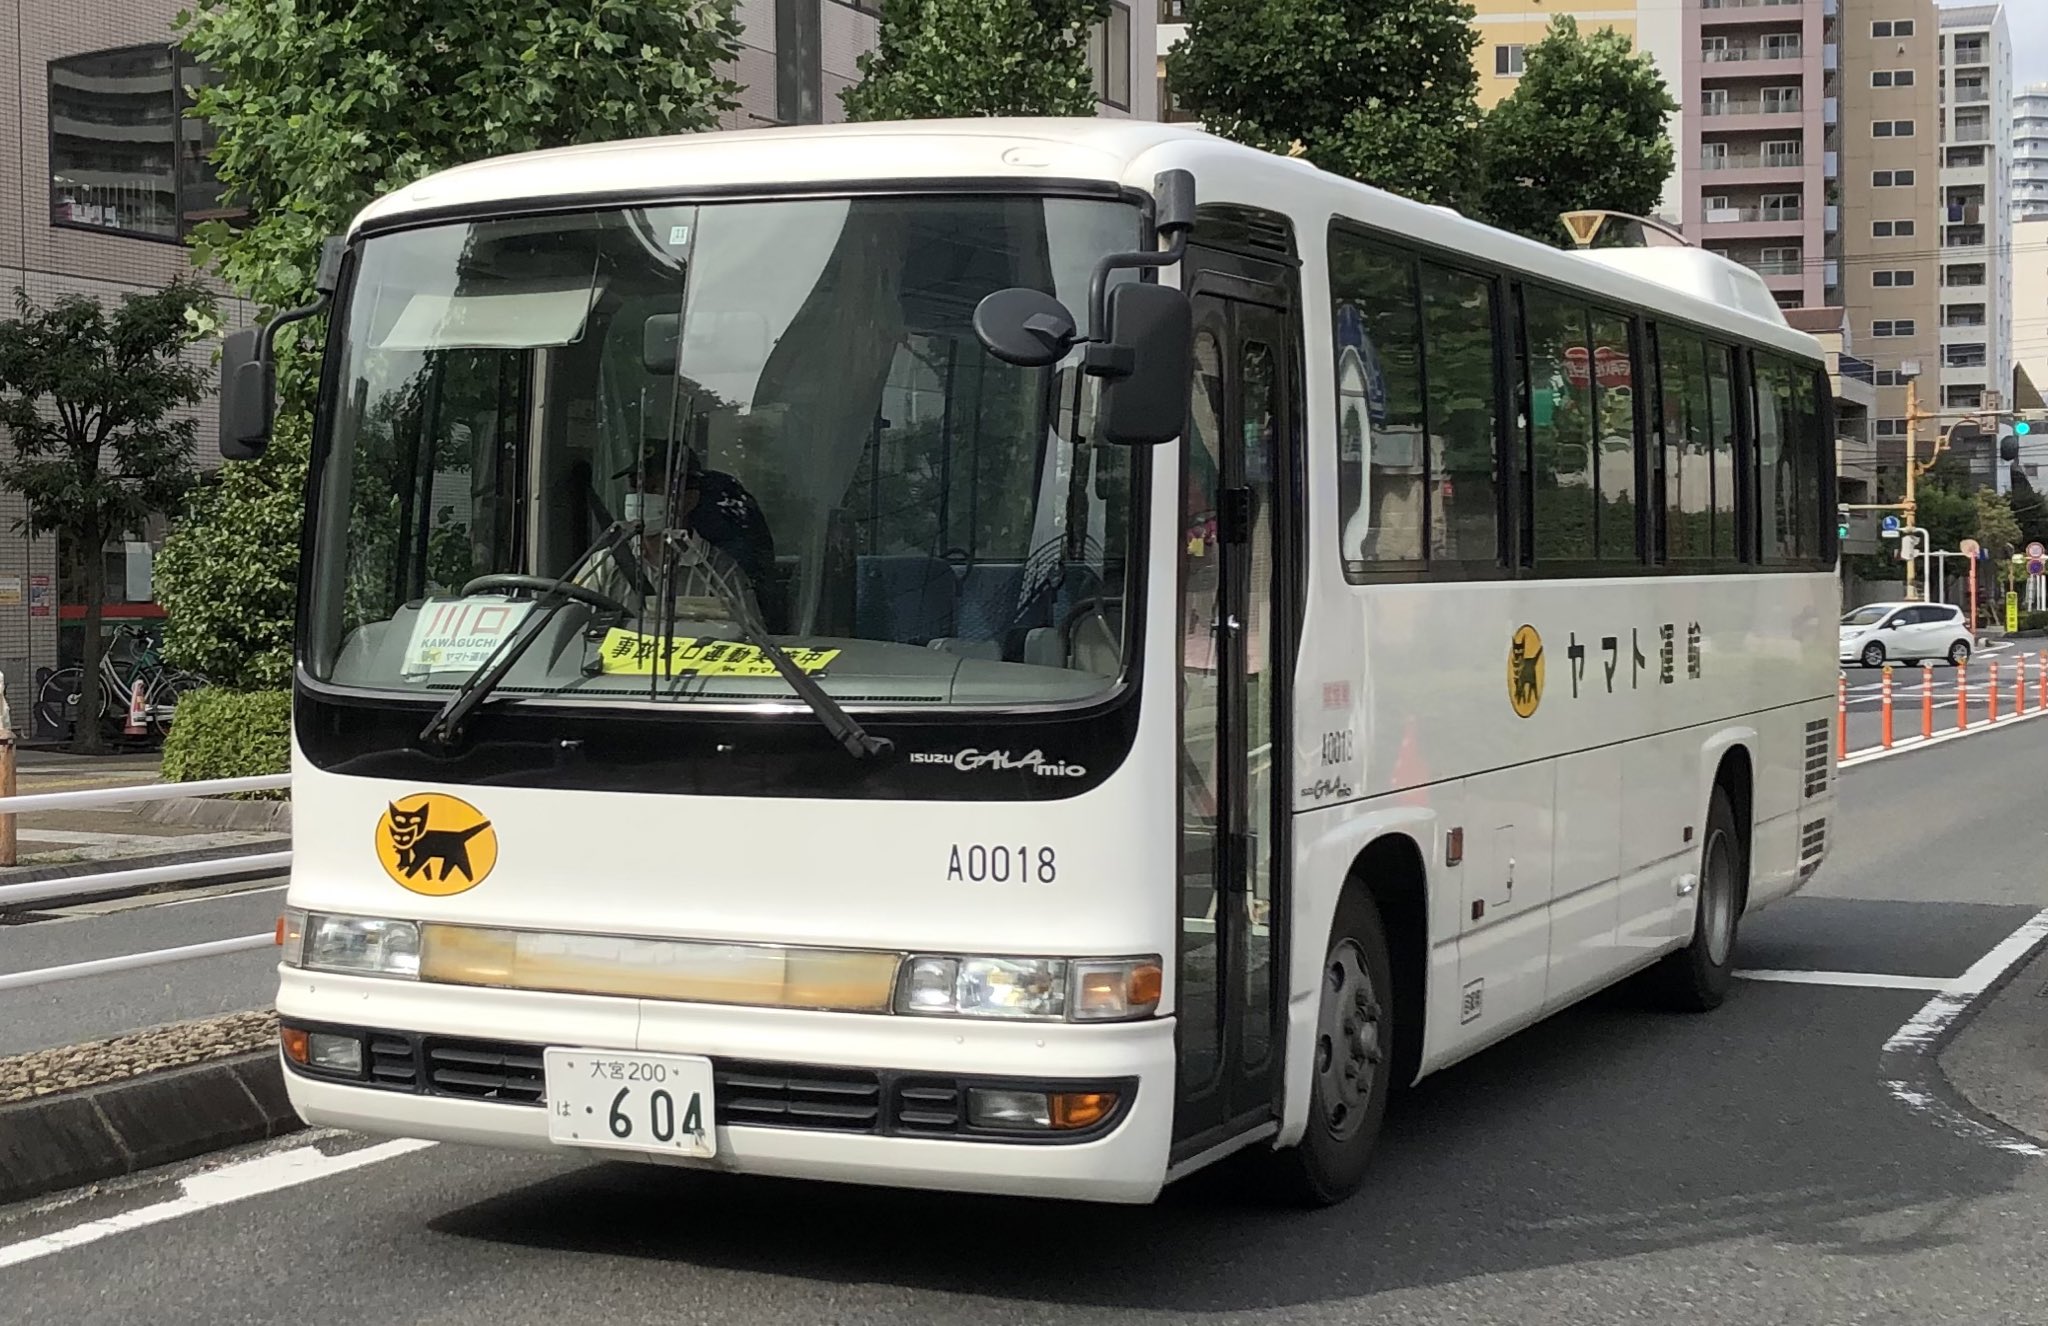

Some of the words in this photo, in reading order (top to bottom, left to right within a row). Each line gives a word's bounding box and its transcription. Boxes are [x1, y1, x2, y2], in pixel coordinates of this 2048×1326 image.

[424, 604, 512, 640] 川口
[421, 638, 498, 648] KAWAGUCHI
[1566, 621, 1701, 699] ヤマト運輸
[910, 753, 954, 763] ISUZU
[947, 844, 1056, 884] A0018
[556, 1100, 571, 1117] は
[609, 1086, 705, 1142] 604
